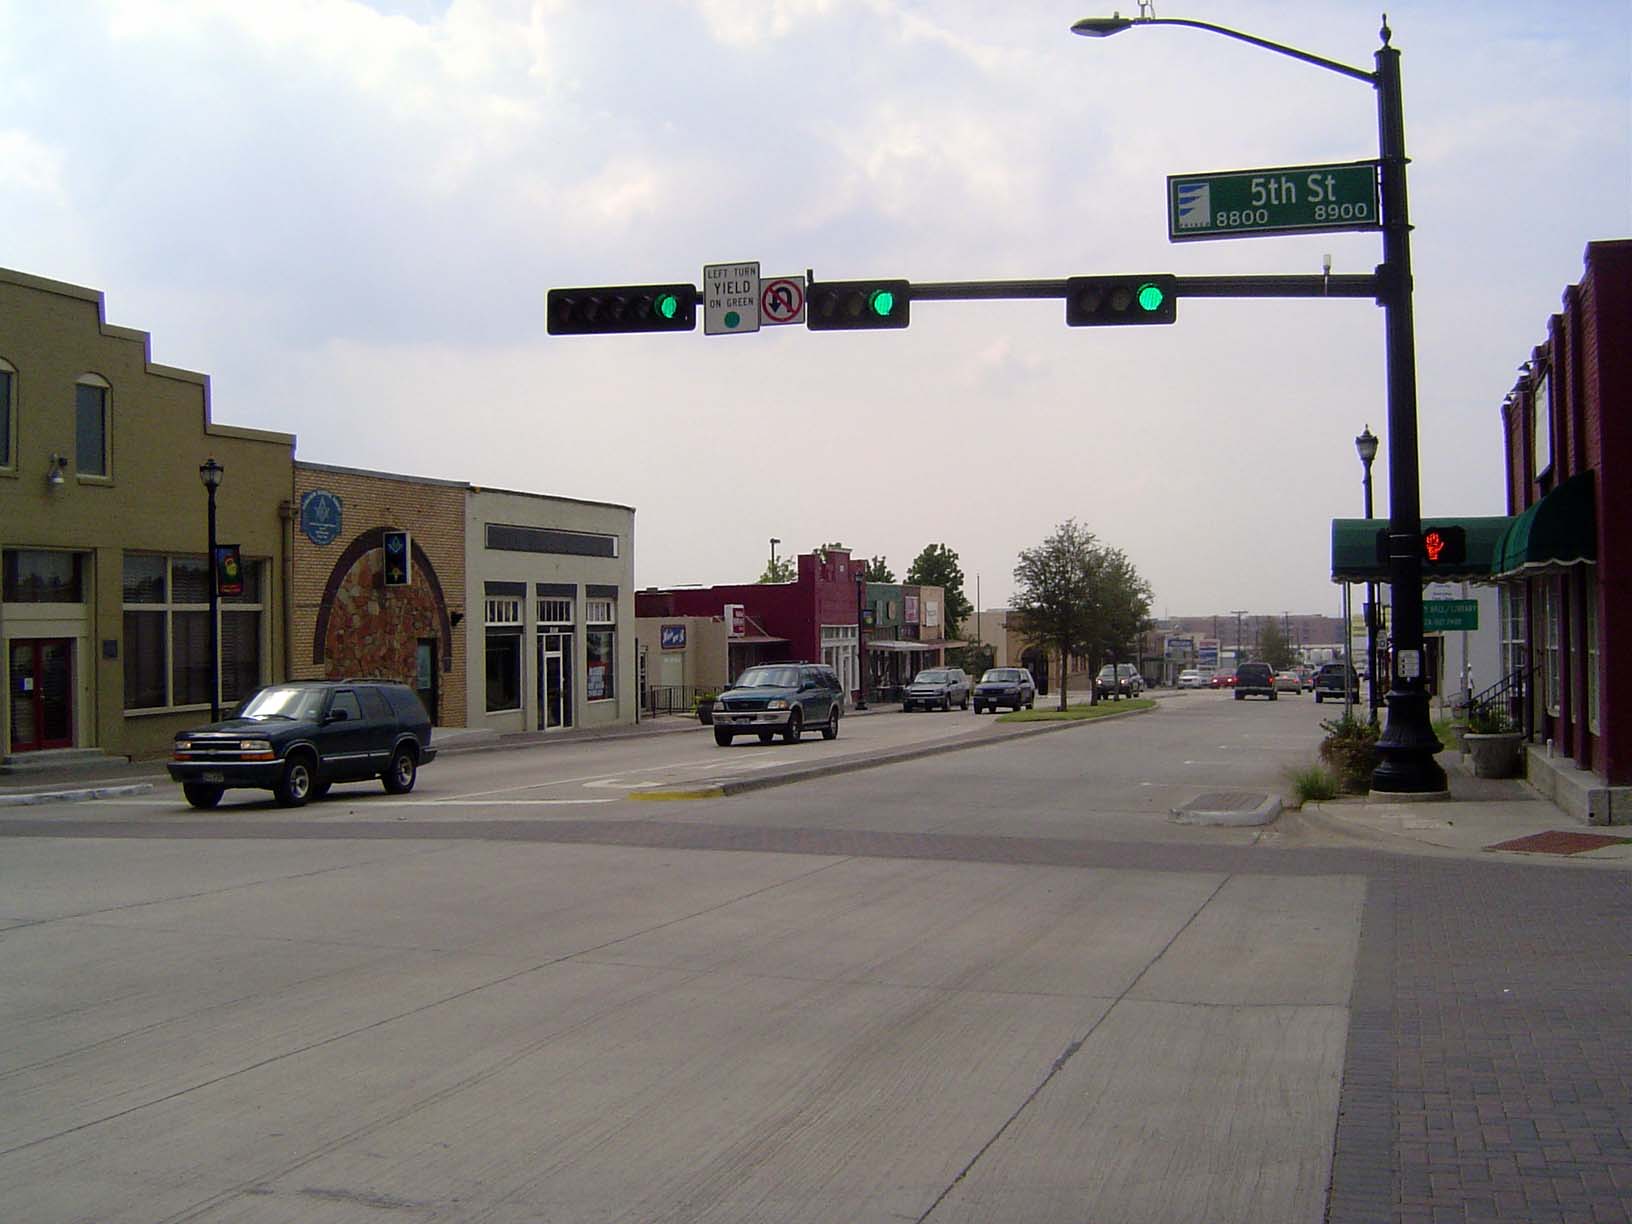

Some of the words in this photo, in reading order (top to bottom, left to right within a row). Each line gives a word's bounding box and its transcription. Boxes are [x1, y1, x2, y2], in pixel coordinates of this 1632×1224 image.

[1251, 176, 1297, 206] 5th
[1307, 174, 1336, 202] St
[1216, 209, 1269, 227] 8800
[1314, 202, 1367, 220] 8900
[707, 269, 728, 279] LEFT
[734, 267, 756, 277] TURN
[714, 280, 751, 295] YIELD
[710, 299, 721, 309] ON
[726, 297, 754, 308] GREEN
